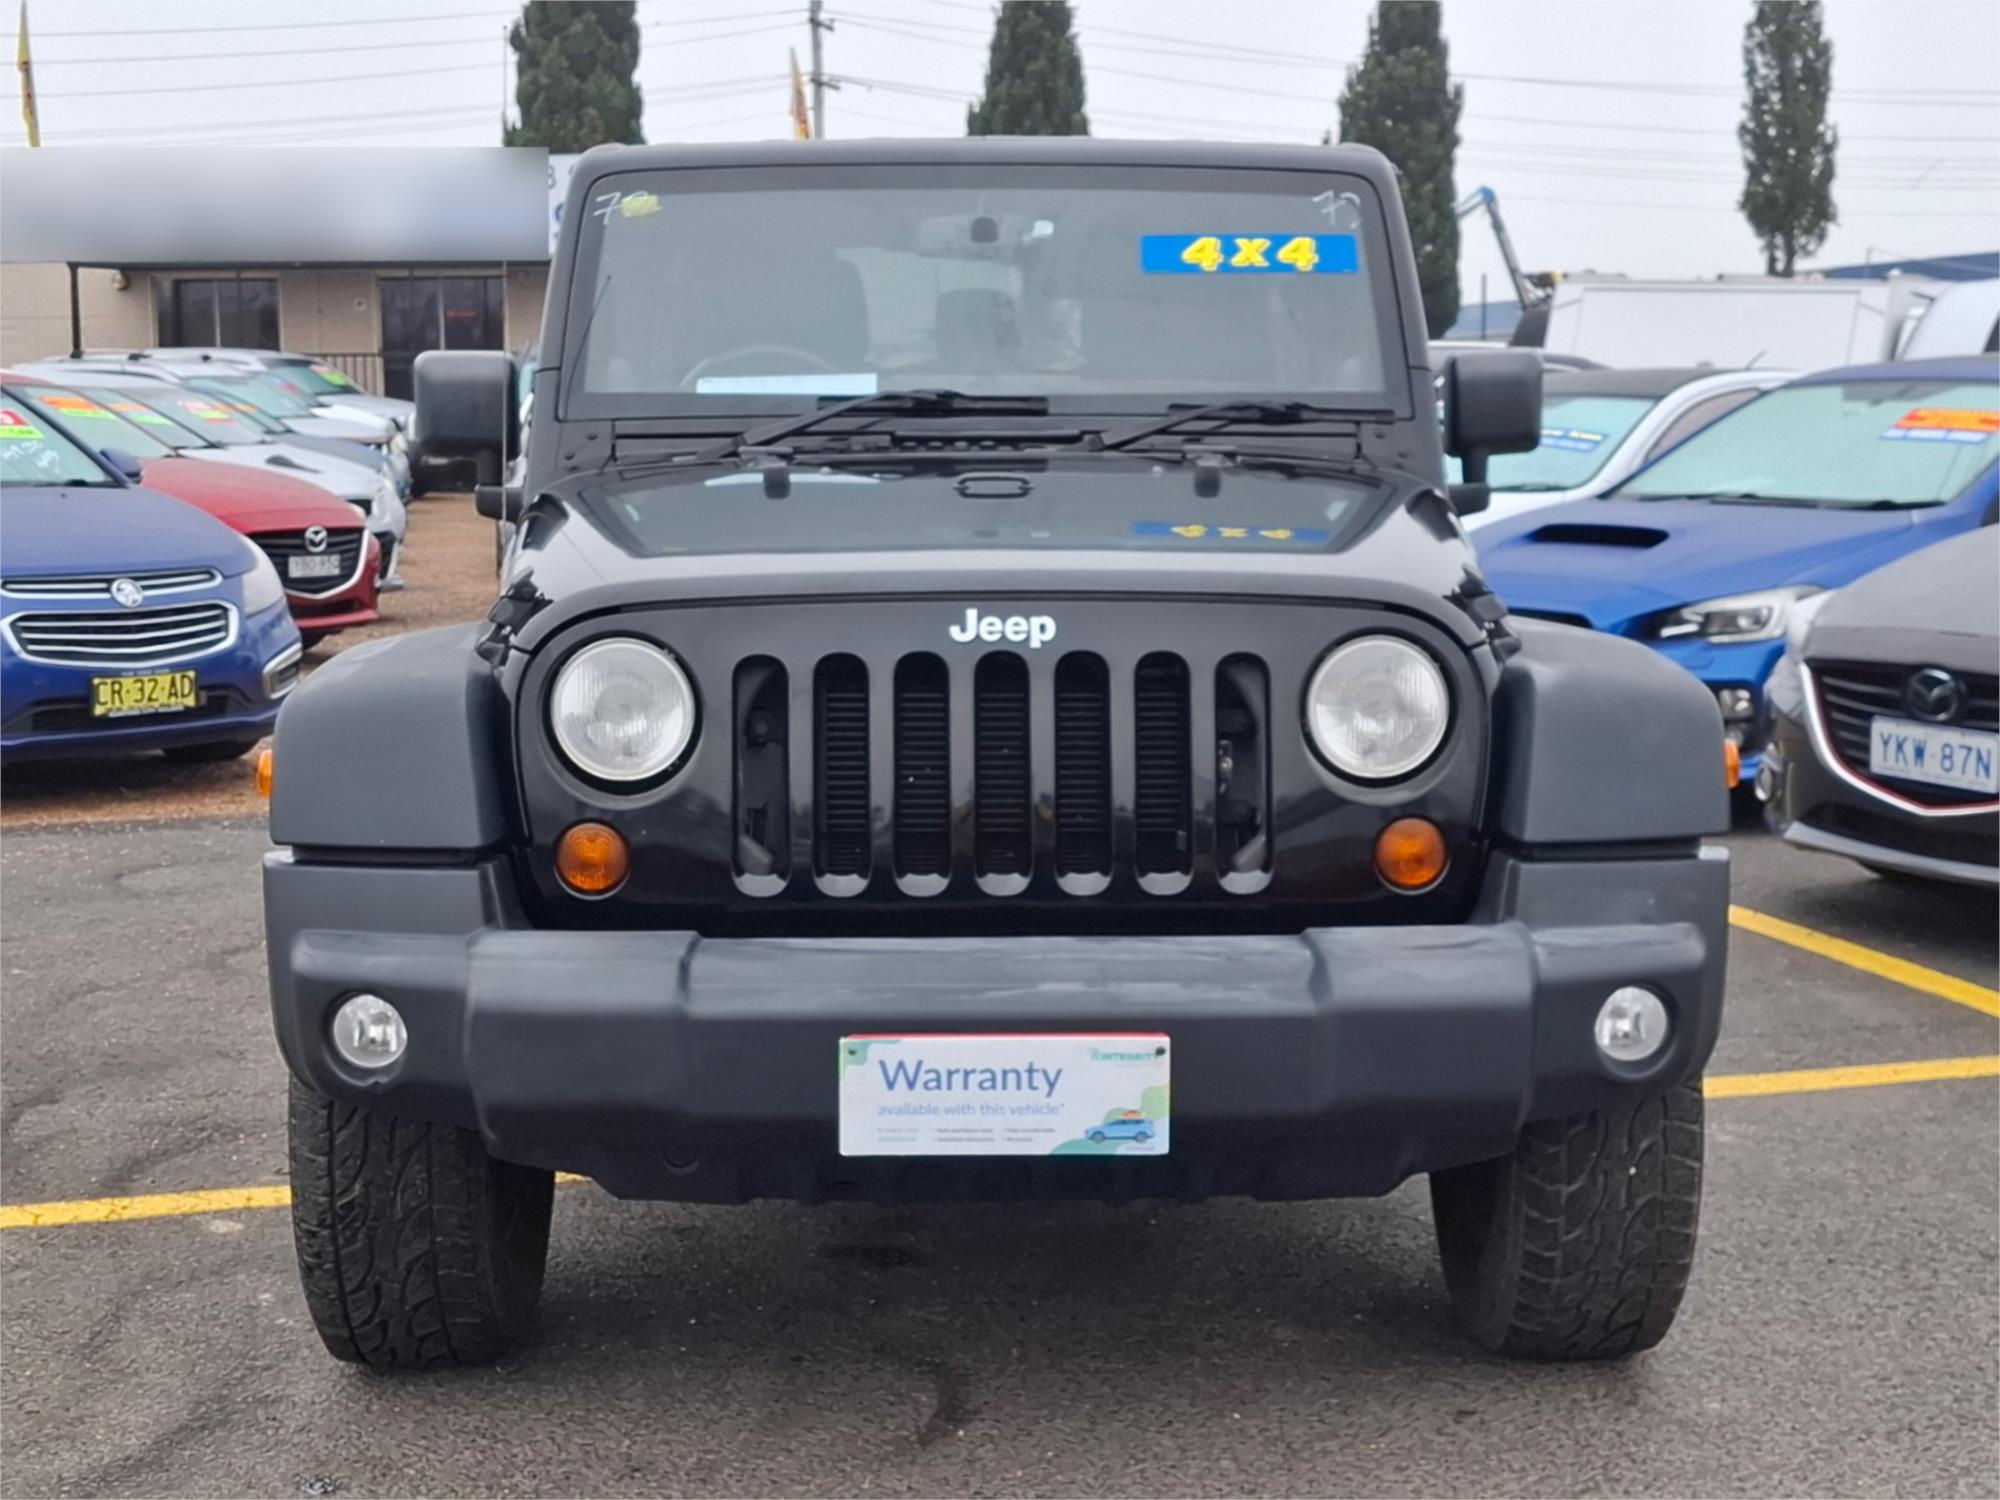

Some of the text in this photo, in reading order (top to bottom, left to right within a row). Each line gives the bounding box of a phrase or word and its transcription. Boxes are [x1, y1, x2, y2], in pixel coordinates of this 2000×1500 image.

[948, 607, 1056, 649] Jeep
[878, 1059, 1063, 1098] Warranty
[877, 1103, 940, 1116] available
[944, 1103, 975, 1116] with
[979, 1103, 1006, 1116] this
